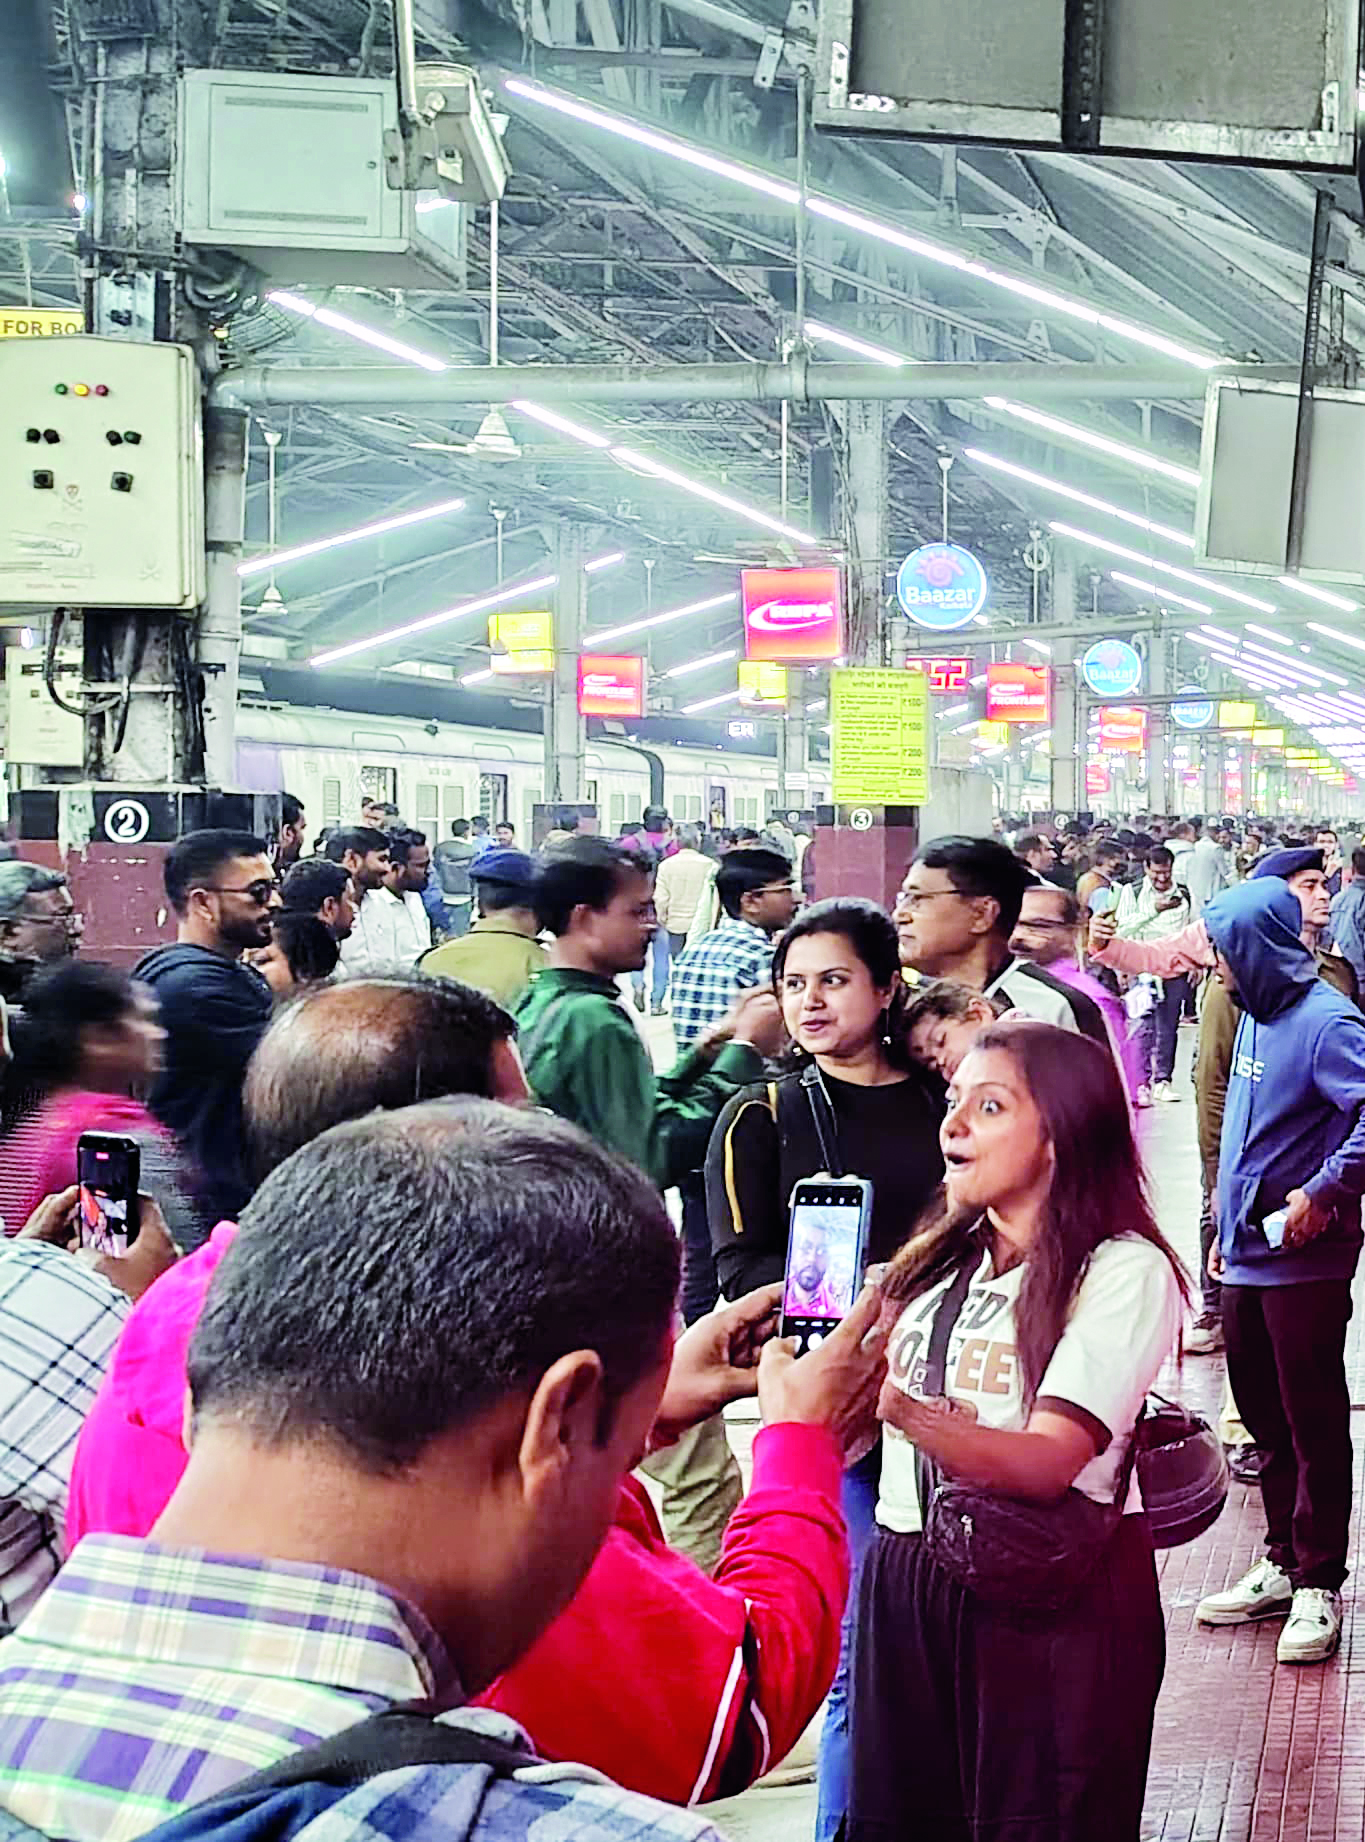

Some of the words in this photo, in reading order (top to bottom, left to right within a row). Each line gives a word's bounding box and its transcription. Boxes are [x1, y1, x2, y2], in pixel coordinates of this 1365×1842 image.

[3, 320, 42, 336] FOR
[50, 321, 84, 335] BO
[905, 586, 976, 604] Baazar
[771, 605, 834, 618] RUPA
[729, 722, 753, 737] ER
[117, 806, 136, 837] 2
